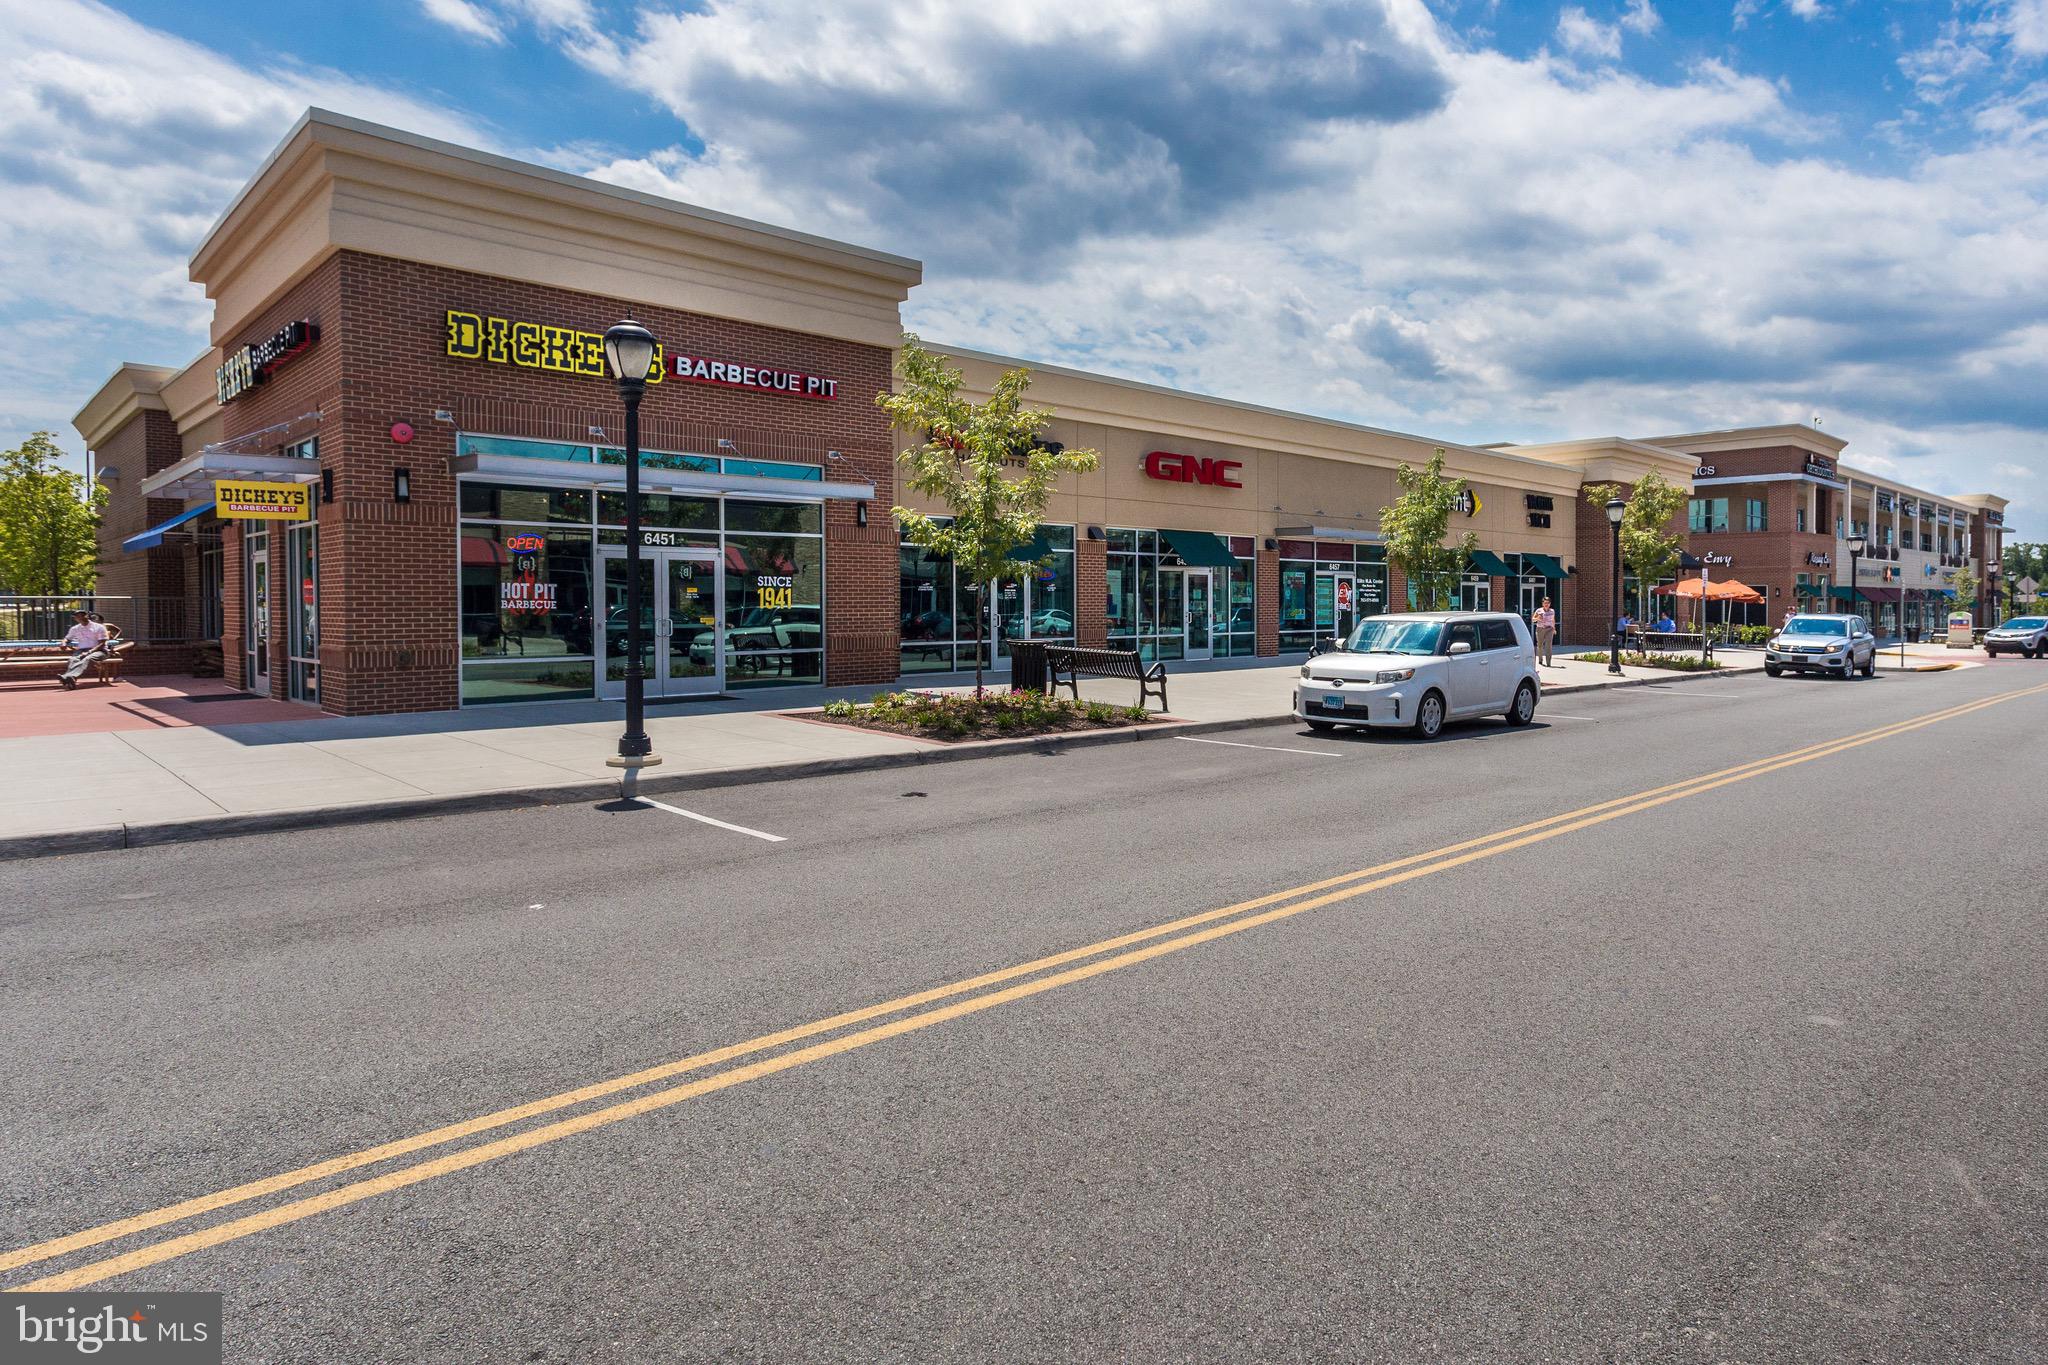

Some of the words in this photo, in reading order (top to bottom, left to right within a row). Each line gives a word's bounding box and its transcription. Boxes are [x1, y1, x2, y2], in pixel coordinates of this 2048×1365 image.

[447, 310, 667, 384] DICKES
[676, 356, 801, 392] BARBECUE
[807, 375, 838, 397] PIT
[1145, 451, 1243, 489] GNC
[220, 487, 305, 505] DICKEY'S
[229, 504, 280, 512] BARBECUE
[507, 537, 545, 550] OPEN
[644, 532, 675, 545] 6451
[1703, 551, 1732, 568] Envy
[757, 575, 792, 587] SINCE
[501, 582, 530, 599] HOT
[534, 583, 558, 600] PIT
[757, 587, 792, 609] 1941
[500, 600, 558, 609] BARBECUE
